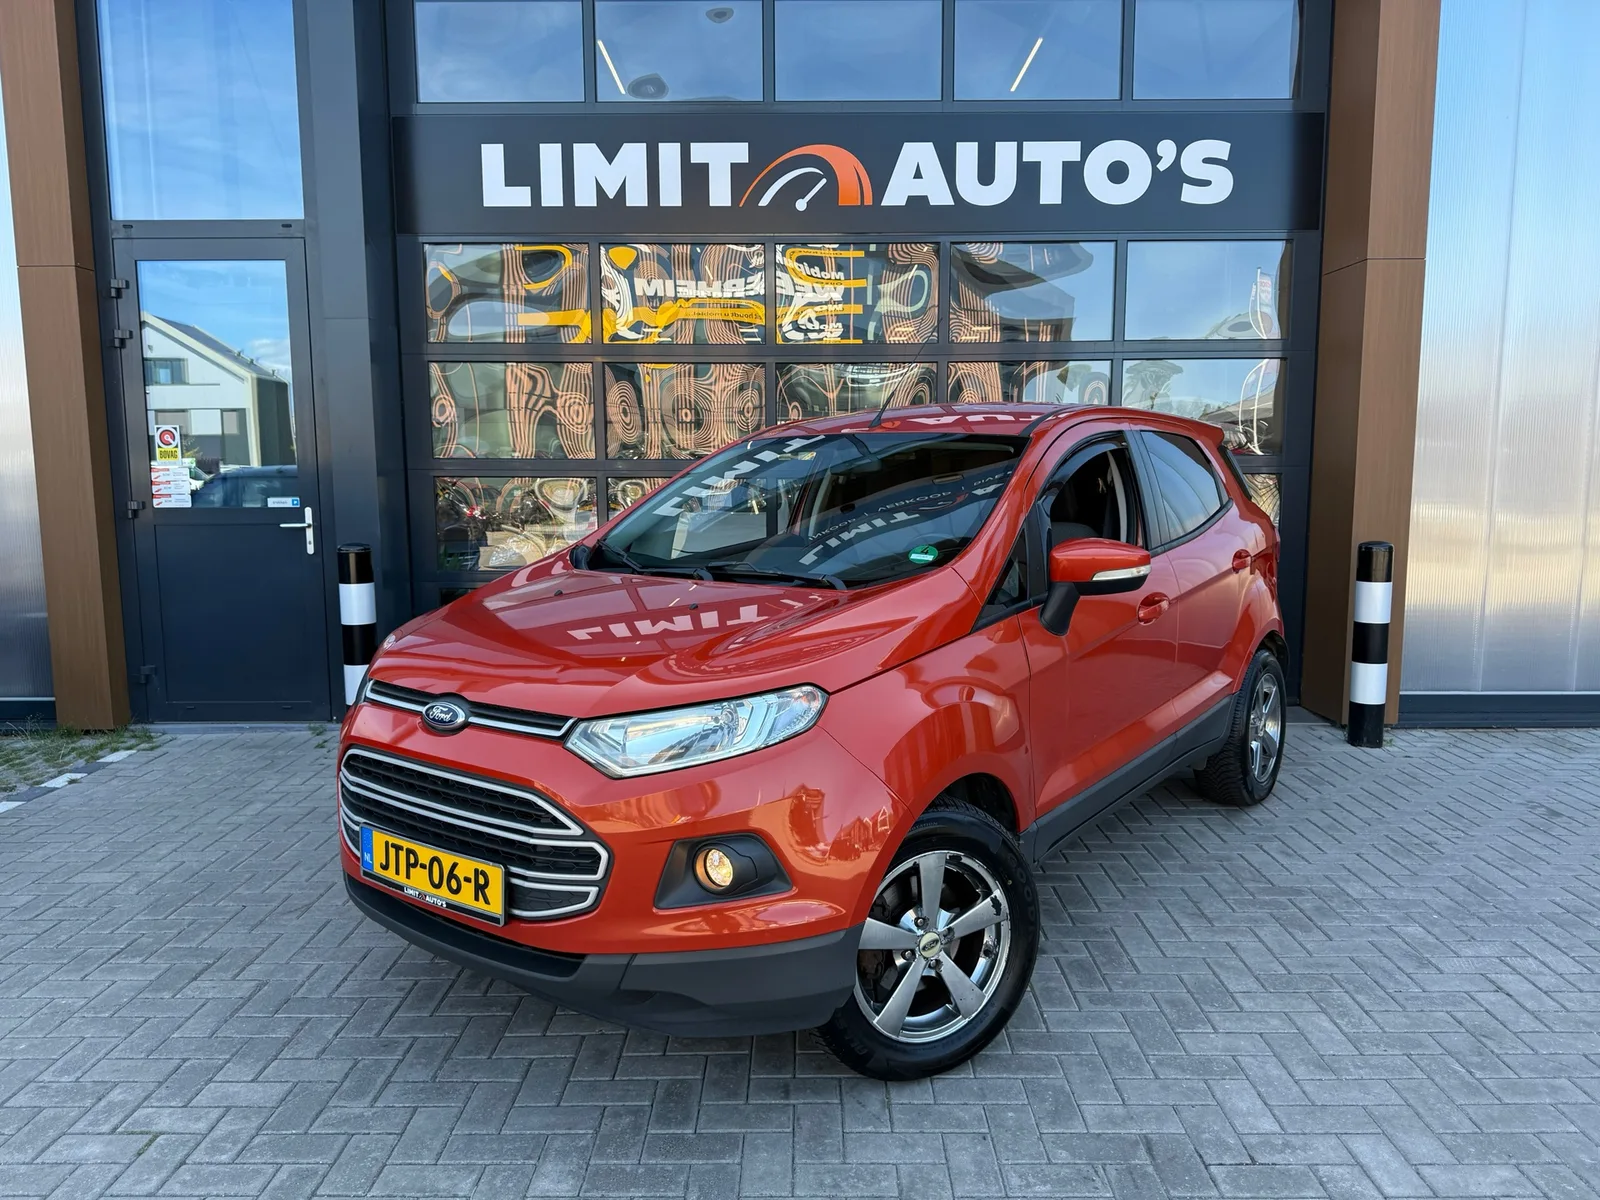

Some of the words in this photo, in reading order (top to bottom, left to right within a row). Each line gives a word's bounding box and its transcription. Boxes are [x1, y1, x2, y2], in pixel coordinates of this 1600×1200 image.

[481, 142, 749, 206] LIMIT
[159, 449, 178, 459] BOVAG
[920, 545, 929, 555] 4
[429, 705, 453, 722] Ford
[364, 851, 373, 864] NL
[379, 839, 491, 906] JTP-06-R
[403, 886, 420, 899] LIMIT
[425, 895, 447, 908] AUTO'S
